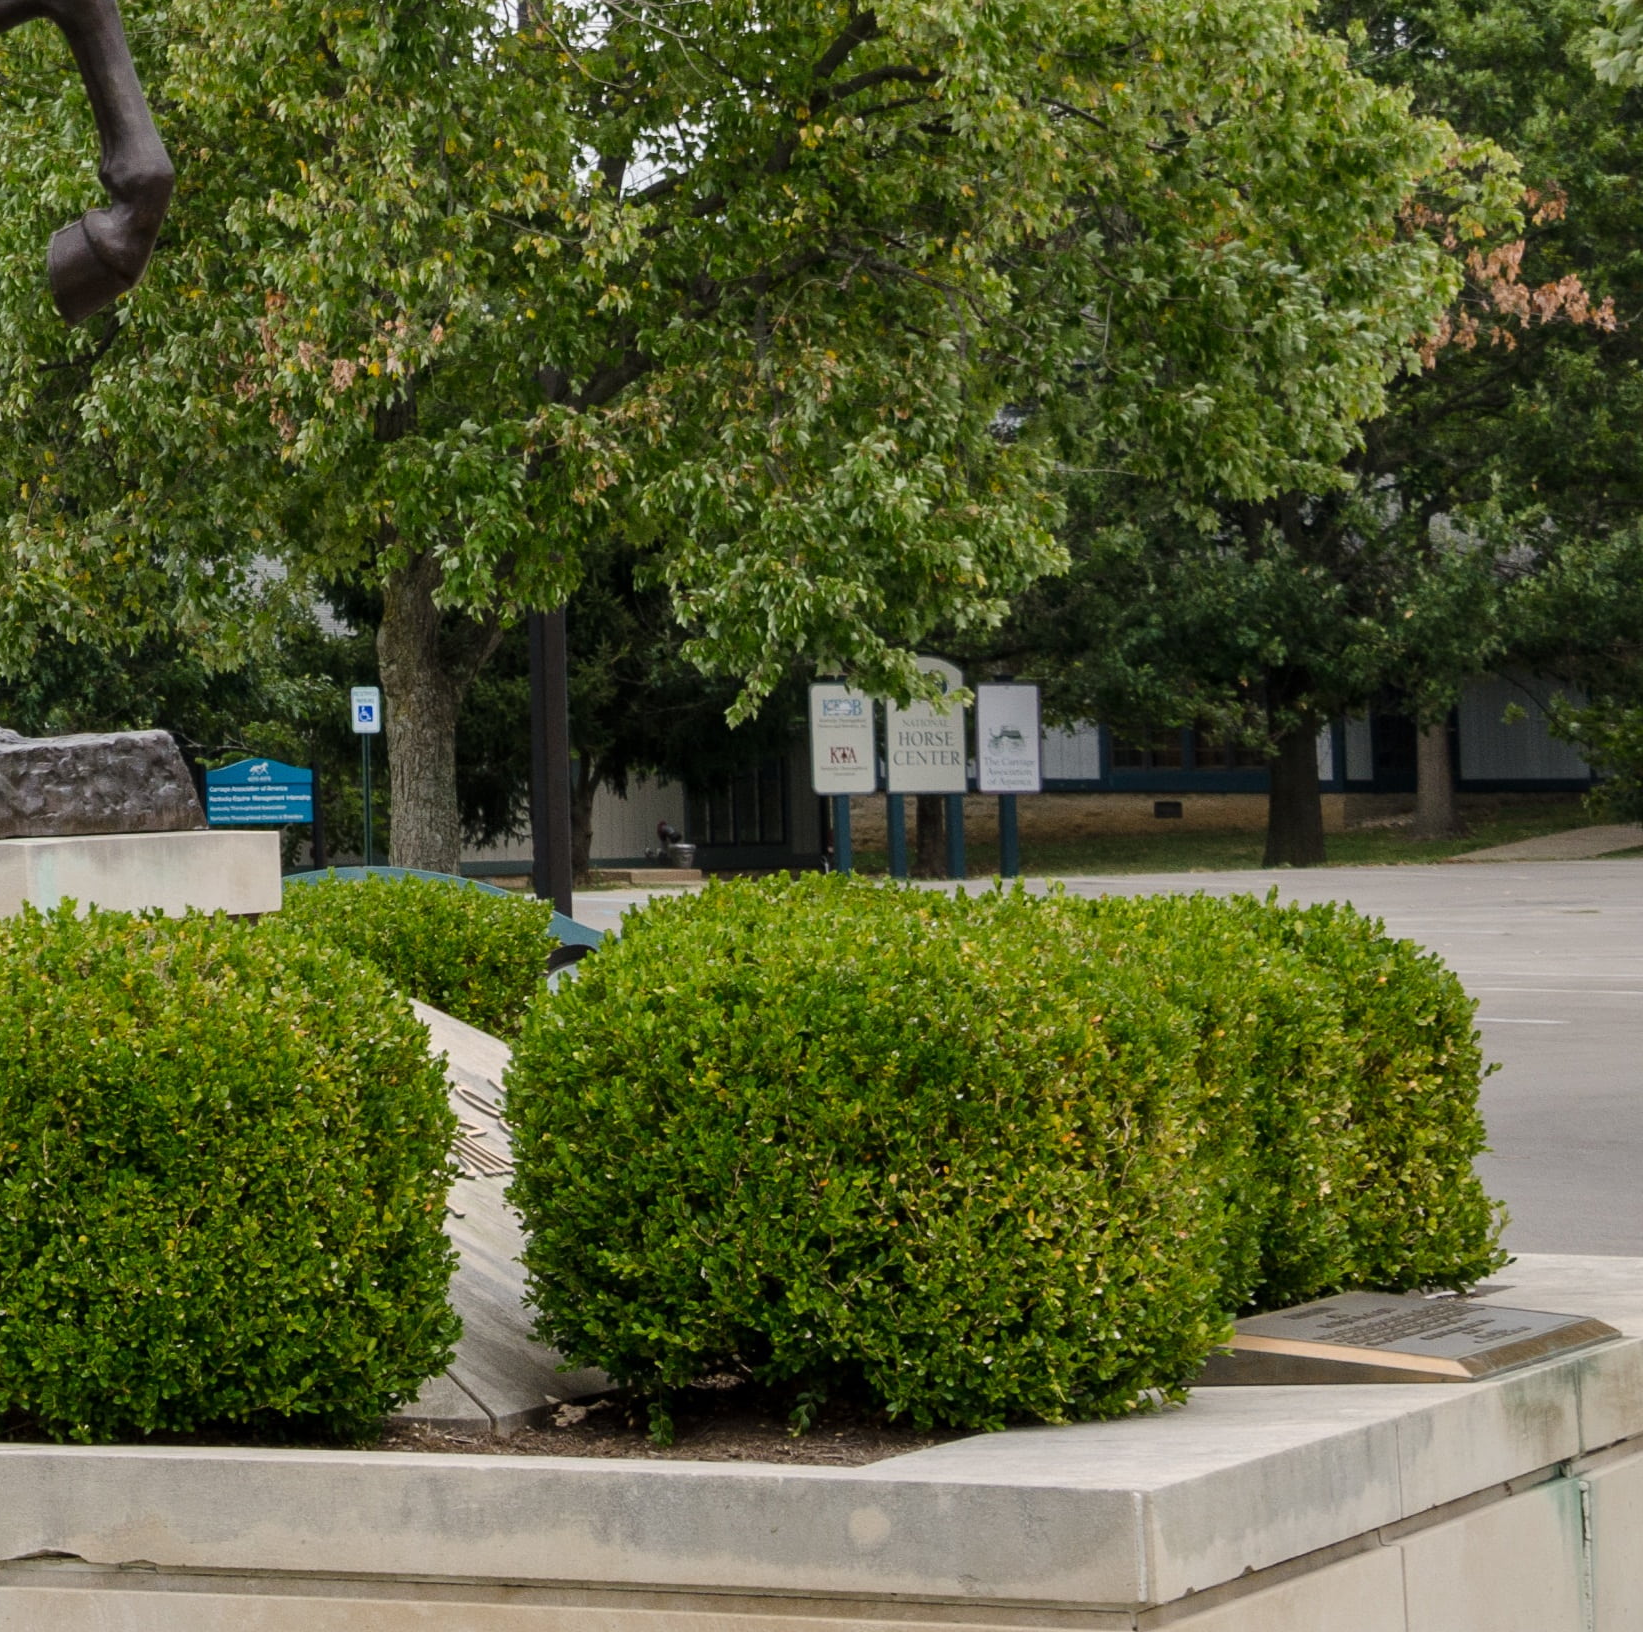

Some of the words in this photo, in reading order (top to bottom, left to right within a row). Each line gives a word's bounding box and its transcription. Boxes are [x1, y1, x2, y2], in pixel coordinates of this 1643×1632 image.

[902, 719, 948, 727] NATIONAL
[898, 731, 955, 746] HORSE
[830, 747, 857, 763] KTA
[893, 750, 961, 766] CENTER
